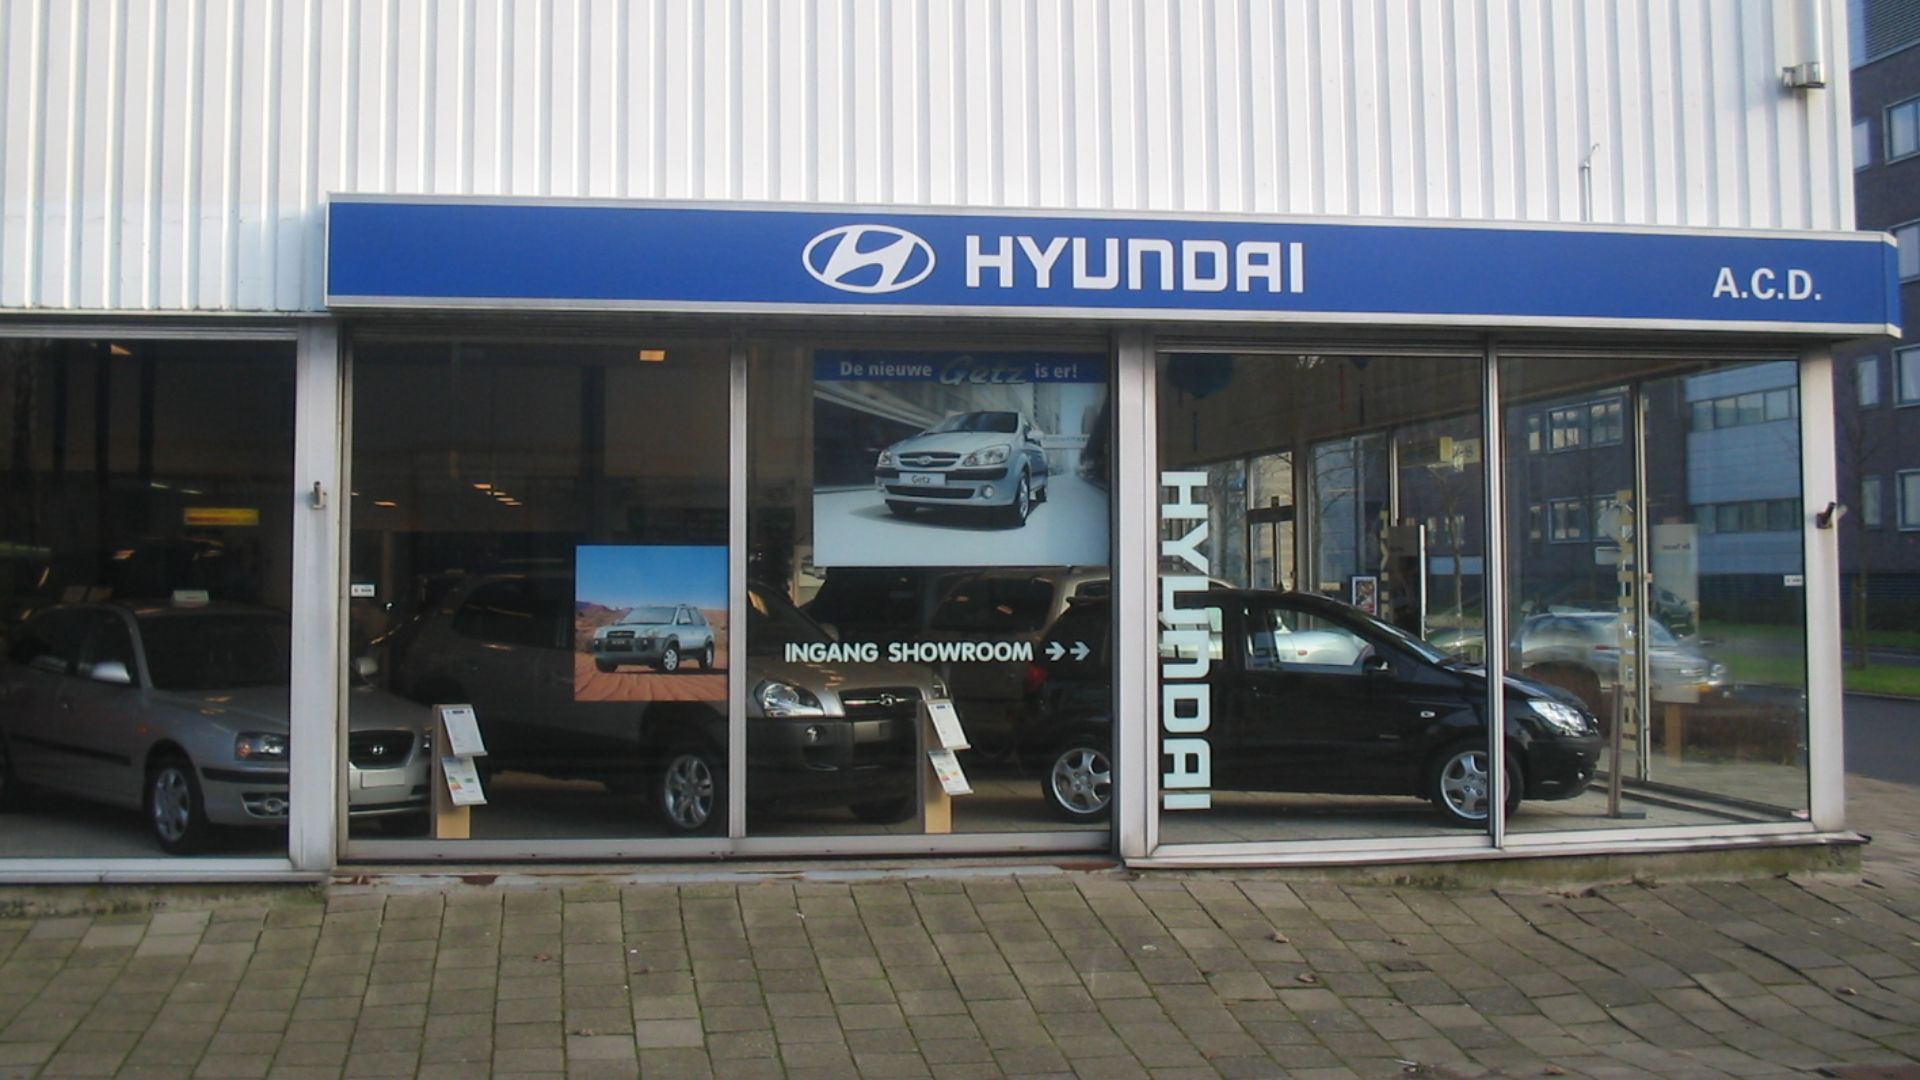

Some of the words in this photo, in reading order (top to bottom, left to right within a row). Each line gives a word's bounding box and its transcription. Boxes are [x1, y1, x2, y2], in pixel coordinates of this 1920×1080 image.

[966, 234, 1303, 293] HYUNDAI
[1712, 266, 1822, 300] A.C.D.
[840, 361, 863, 376] De
[868, 360, 932, 377] nieuwe
[940, 355, 1027, 384] Getz
[1035, 362, 1049, 378] is
[1054, 363, 1078, 378] er!
[784, 642, 879, 663] INGANG
[888, 641, 1033, 662] SHOWROOM
[1161, 472, 1211, 810] HYUNDAI
